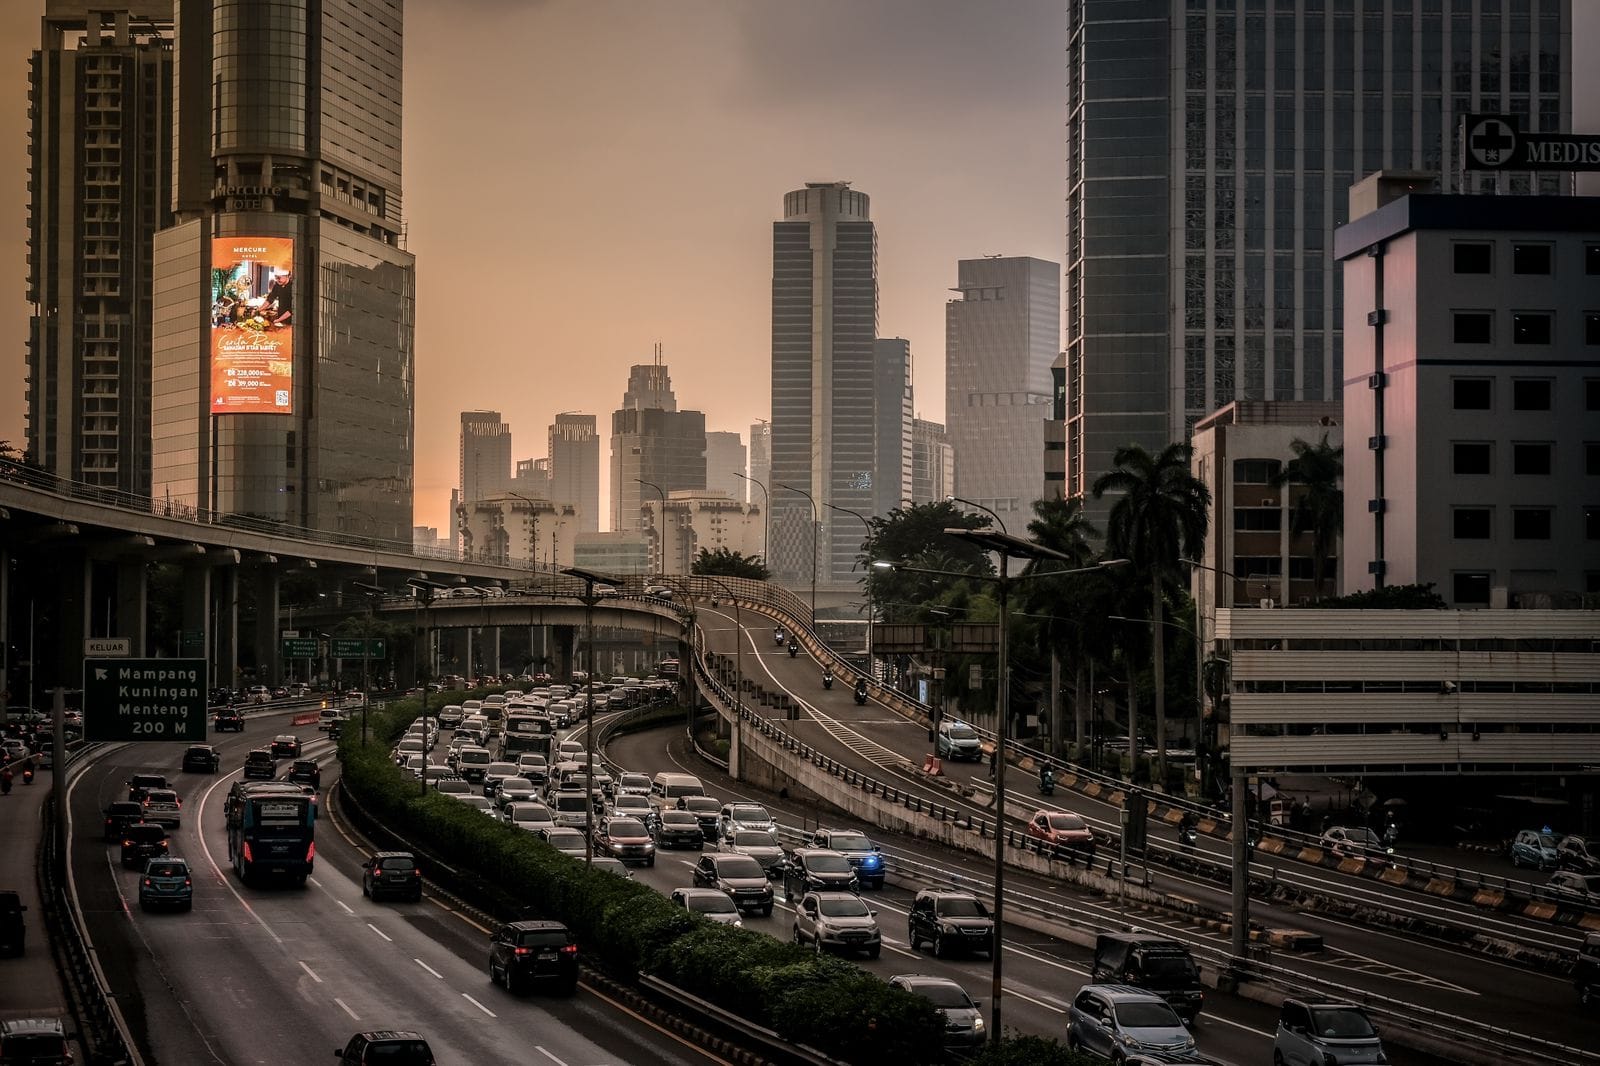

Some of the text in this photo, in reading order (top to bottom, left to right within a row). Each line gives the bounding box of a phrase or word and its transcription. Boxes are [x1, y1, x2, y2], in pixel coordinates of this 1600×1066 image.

[1526, 141, 1600, 164] MEDIS
[119, 667, 197, 682] Mampang
[119, 685, 198, 700] Kuningan
[119, 703, 188, 718] Menteng
[132, 721, 186, 734] 200 M
